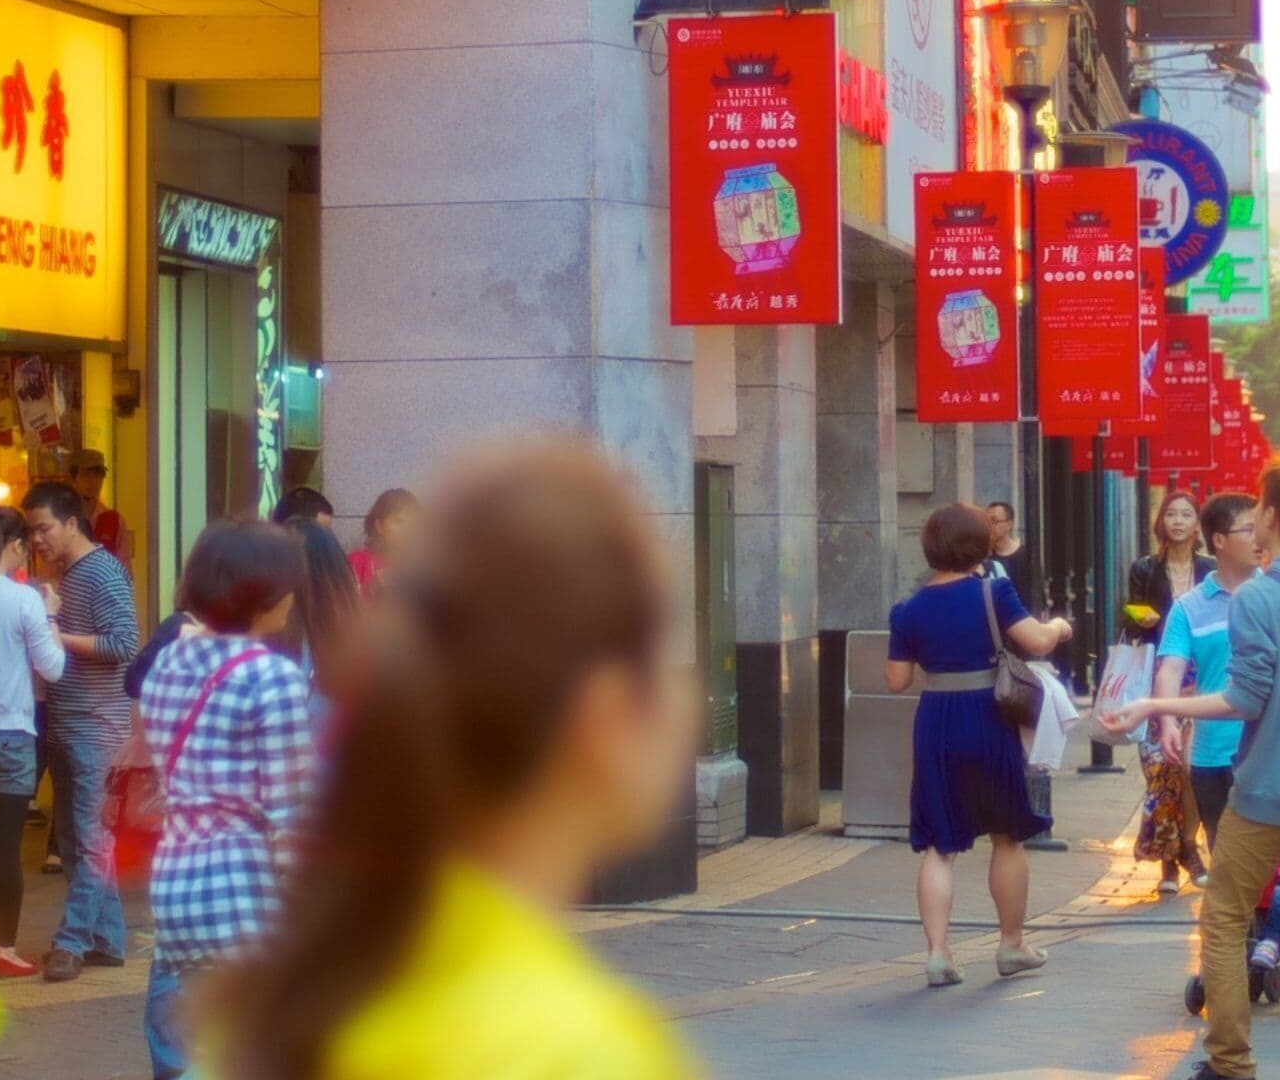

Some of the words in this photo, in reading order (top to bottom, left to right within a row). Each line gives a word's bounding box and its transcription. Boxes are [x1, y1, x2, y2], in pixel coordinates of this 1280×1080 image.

[727, 87, 776, 98] YUEXIU
[715, 98, 759, 108] TEMPLE
[763, 97, 789, 107] FAIR
[945, 227, 984, 236] YUEXIU
[936, 236, 969, 244] TEMPLE
[972, 235, 994, 243] FAIR
[38, 223, 97, 278] HIANG
